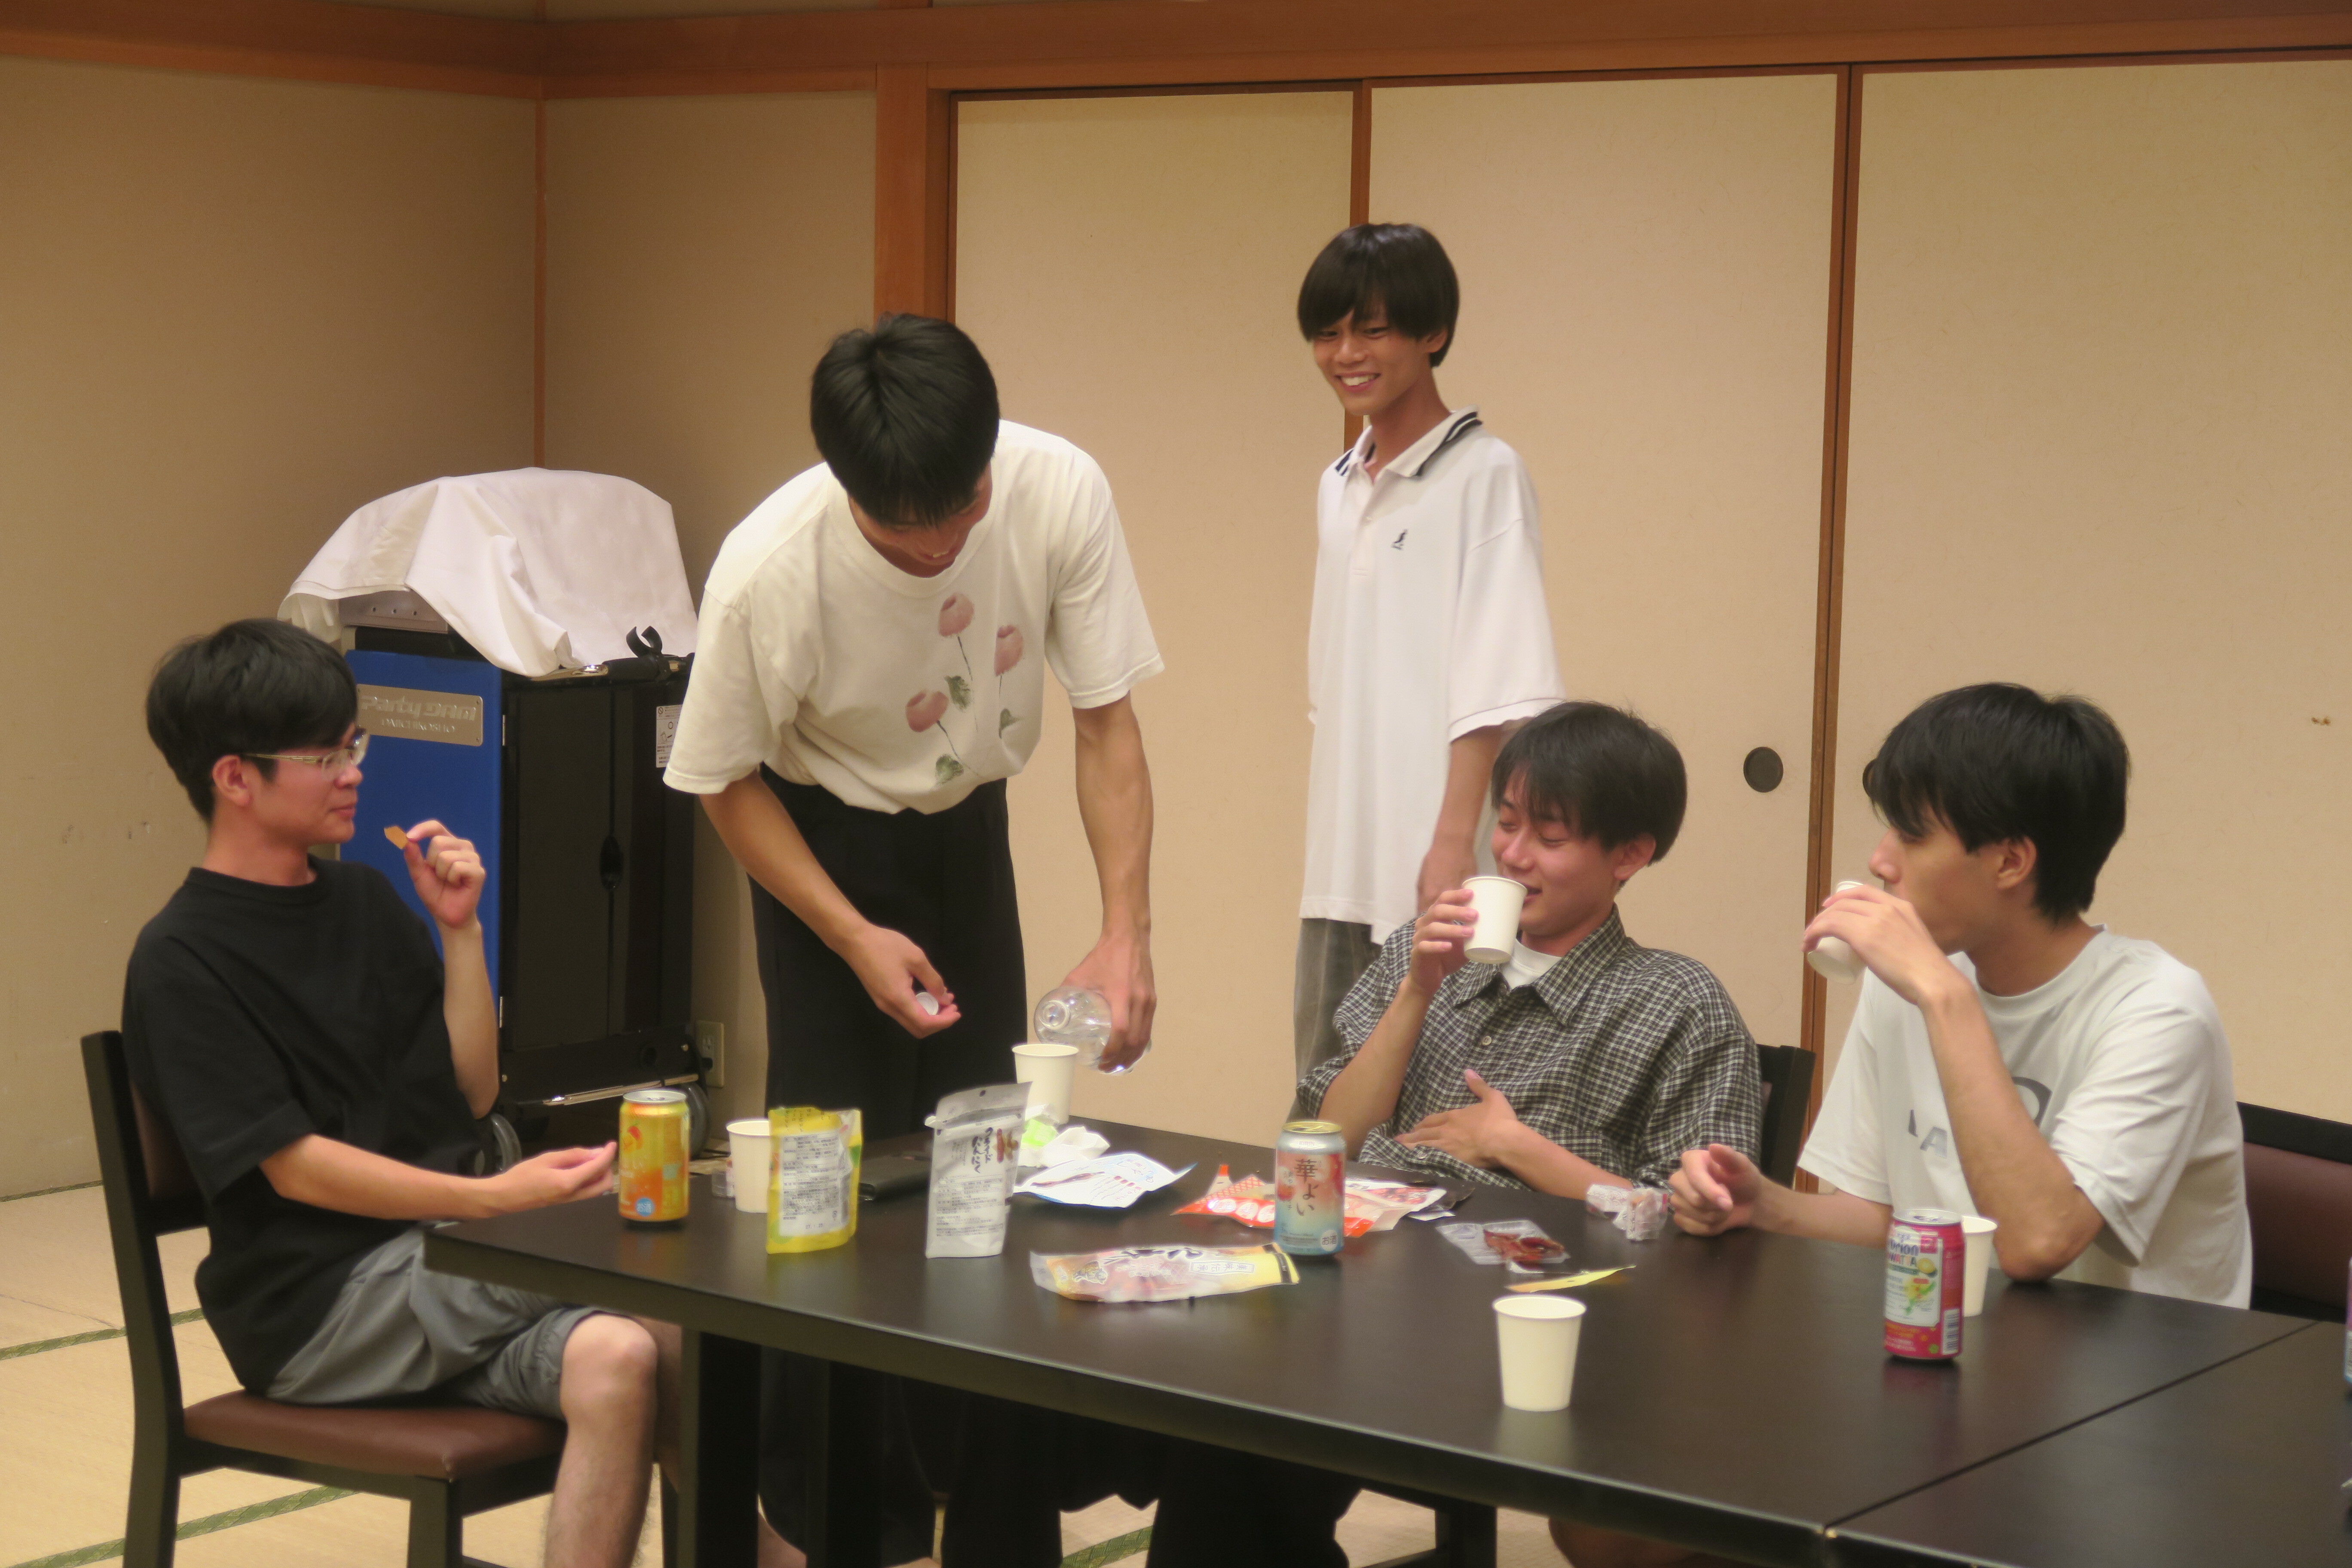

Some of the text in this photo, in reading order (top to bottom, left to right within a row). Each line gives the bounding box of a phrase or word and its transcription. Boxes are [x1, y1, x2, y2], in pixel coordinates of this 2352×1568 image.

[360, 695, 422, 719] Party
[382, 718, 456, 733] DAIICHIKOSHO
[971, 1136, 986, 1174] にんにく
[983, 1127, 994, 1164] フライド
[1294, 1159, 1319, 1216] 華よい
[1322, 1234, 1337, 1246] お酒
